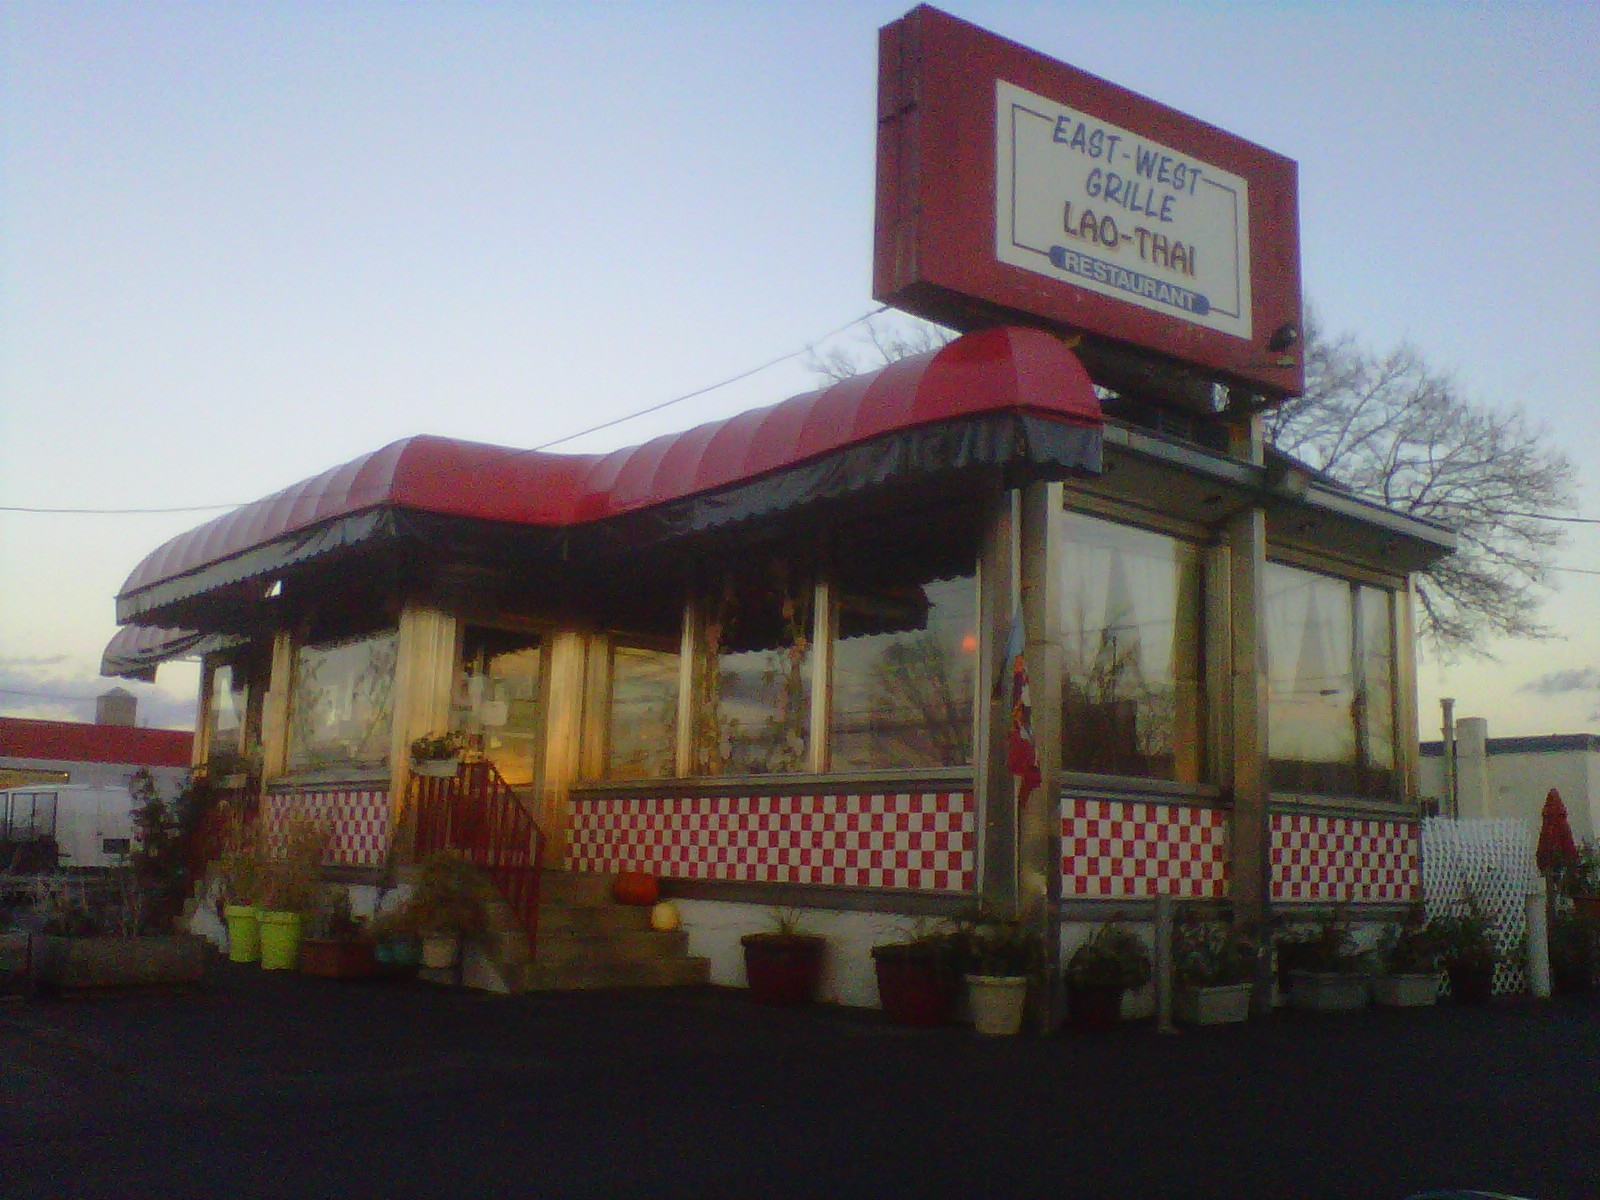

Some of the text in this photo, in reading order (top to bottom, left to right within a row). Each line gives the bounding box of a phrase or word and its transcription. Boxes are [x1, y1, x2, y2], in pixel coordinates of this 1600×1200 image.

[1053, 115, 1201, 196] EAST-WEST
[1086, 167, 1176, 222] GRILLE
[1063, 200, 1196, 277] LAO-THAI
[1064, 252, 1194, 311] RESTAURANT
